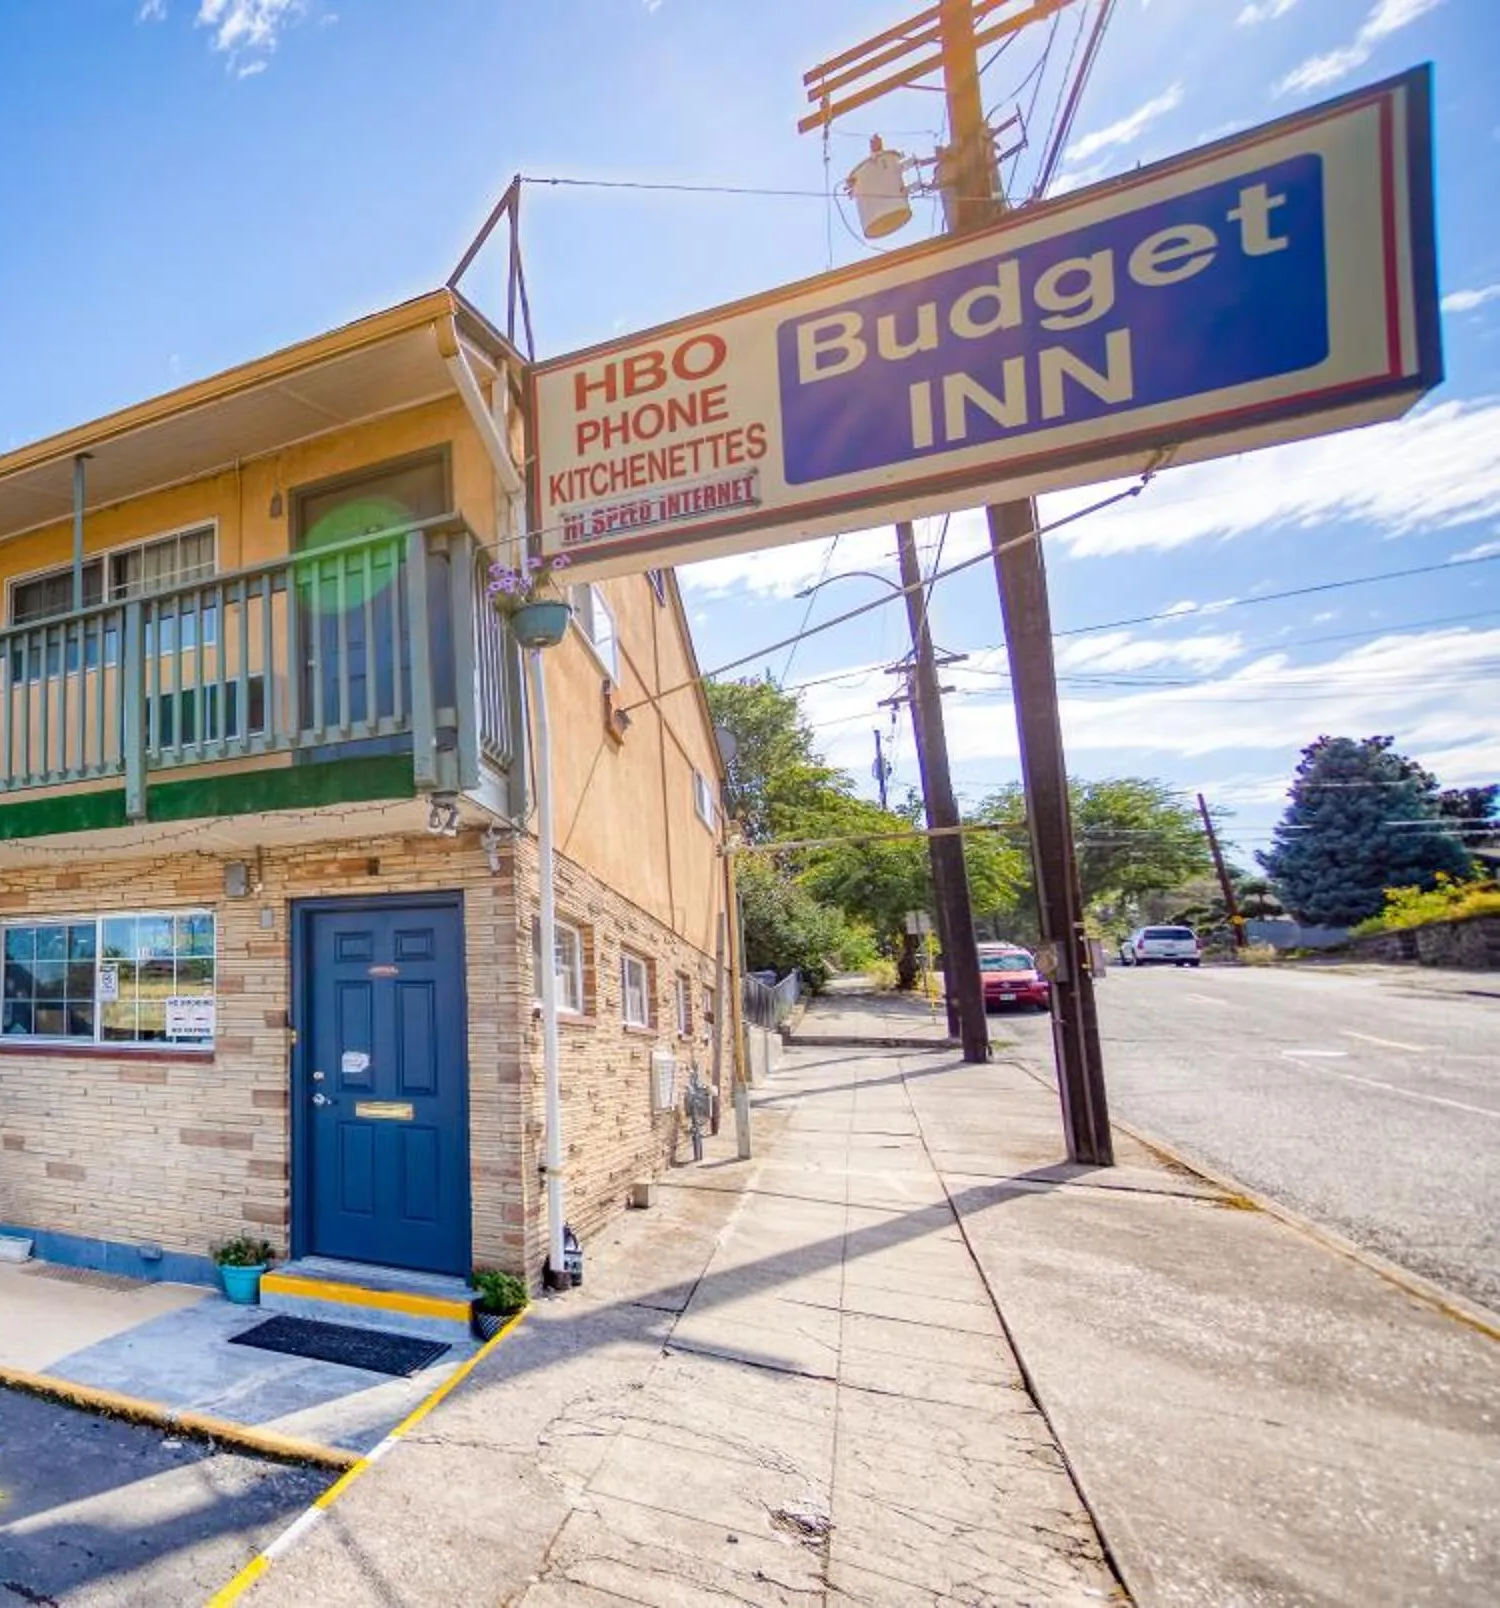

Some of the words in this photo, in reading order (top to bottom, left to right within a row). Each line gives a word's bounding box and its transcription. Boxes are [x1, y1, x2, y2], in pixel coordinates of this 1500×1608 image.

[797, 182, 1289, 385] Budget
[574, 333, 727, 412] HBO
[909, 328, 1134, 449] INN
[576, 384, 729, 456] PHONE
[549, 422, 767, 507] KITCHENETTES
[592, 500, 651, 535] SPEED
[659, 475, 754, 521] INTERNET
